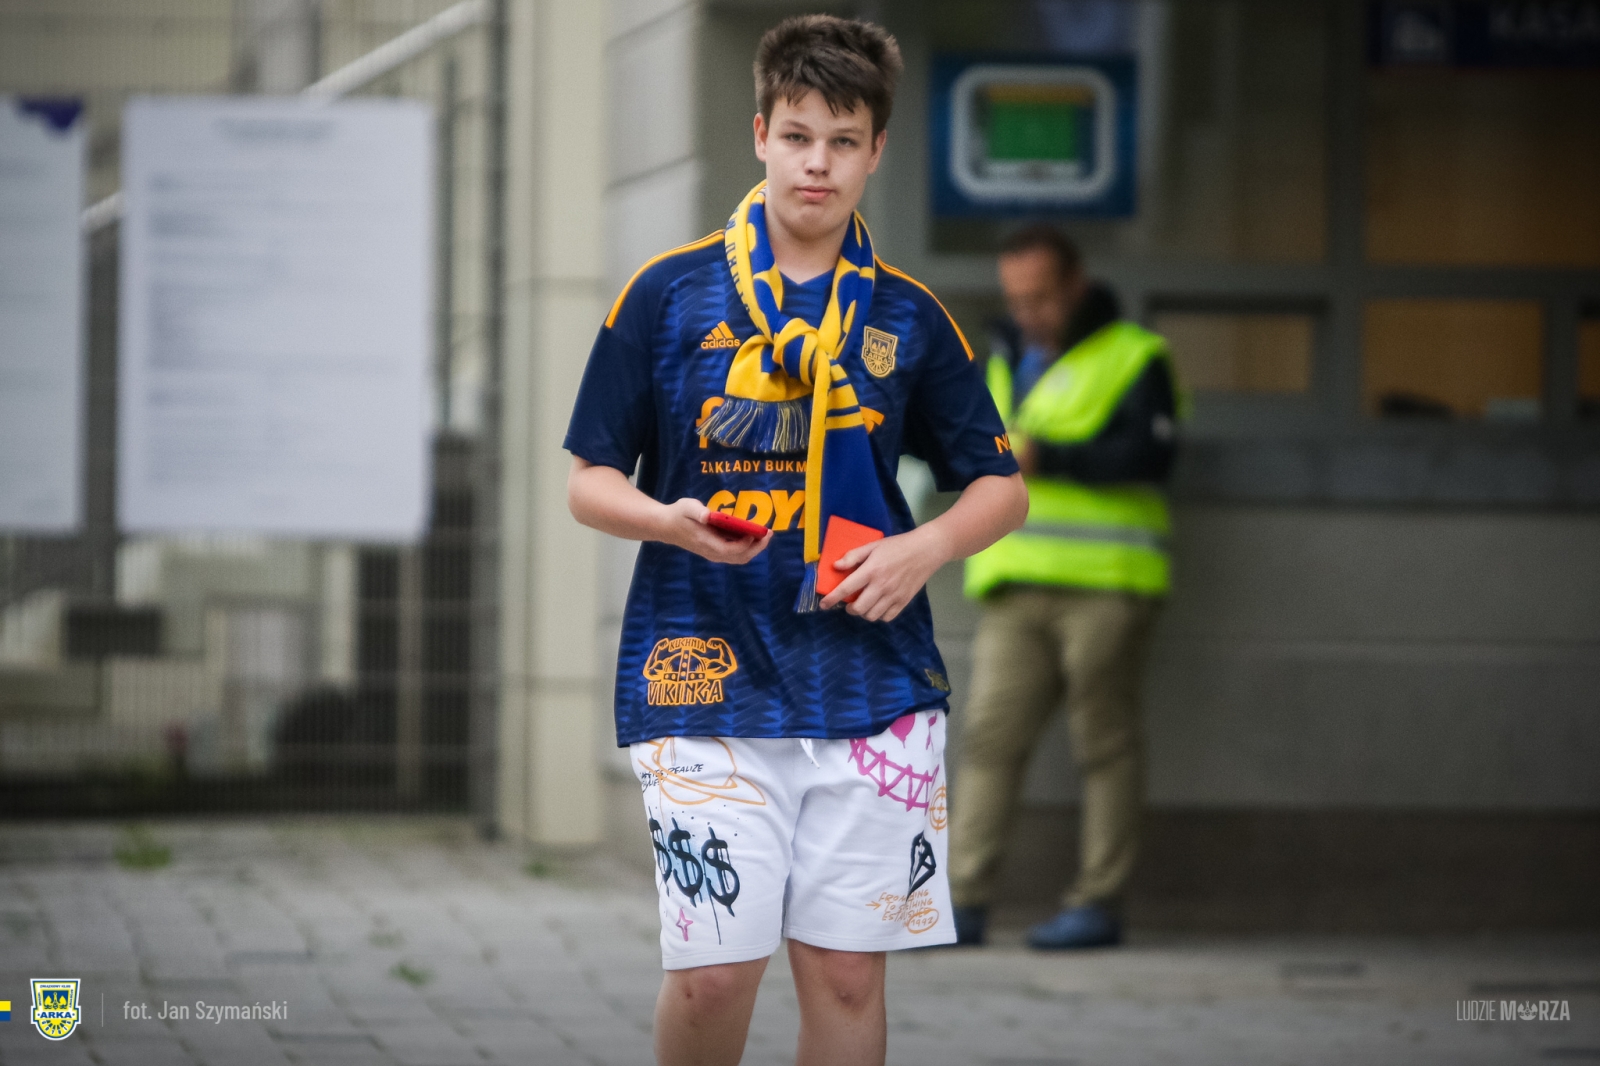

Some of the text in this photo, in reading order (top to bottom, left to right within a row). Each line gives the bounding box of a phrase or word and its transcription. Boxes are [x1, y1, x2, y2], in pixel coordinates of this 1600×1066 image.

[701, 337, 740, 349] adidas
[700, 459, 760, 474] ZAKŁADY
[706, 489, 806, 531] GDY
[669, 637, 706, 651] KUCHNIA
[647, 679, 724, 706] VIKINGA
